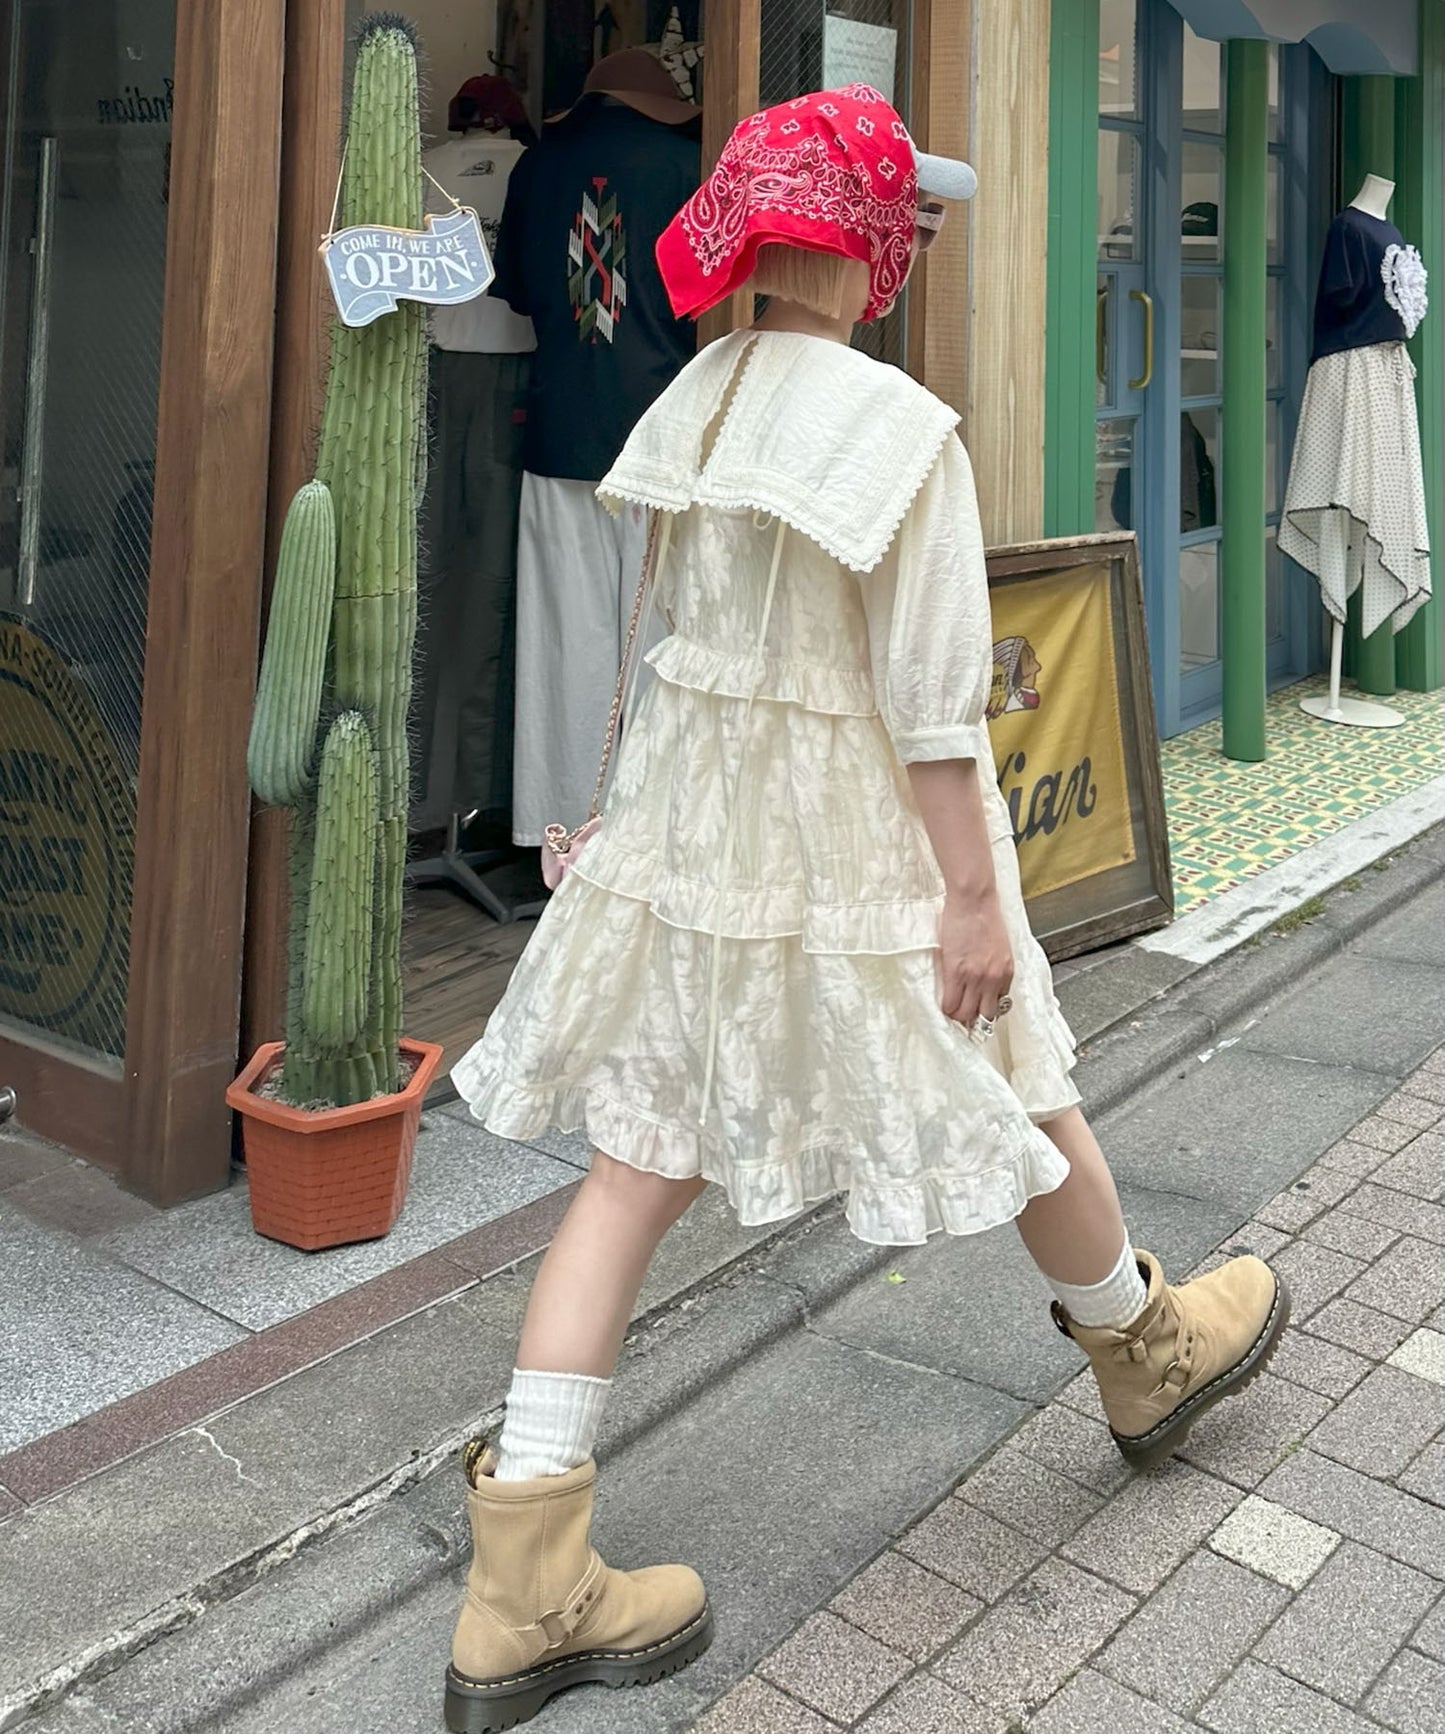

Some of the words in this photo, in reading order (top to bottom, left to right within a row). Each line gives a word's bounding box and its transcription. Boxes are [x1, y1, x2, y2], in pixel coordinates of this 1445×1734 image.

[341, 234, 381, 255] COME
[409, 240, 431, 254] WE
[436, 235, 464, 253] ARE
[345, 250, 476, 292] OPEN
